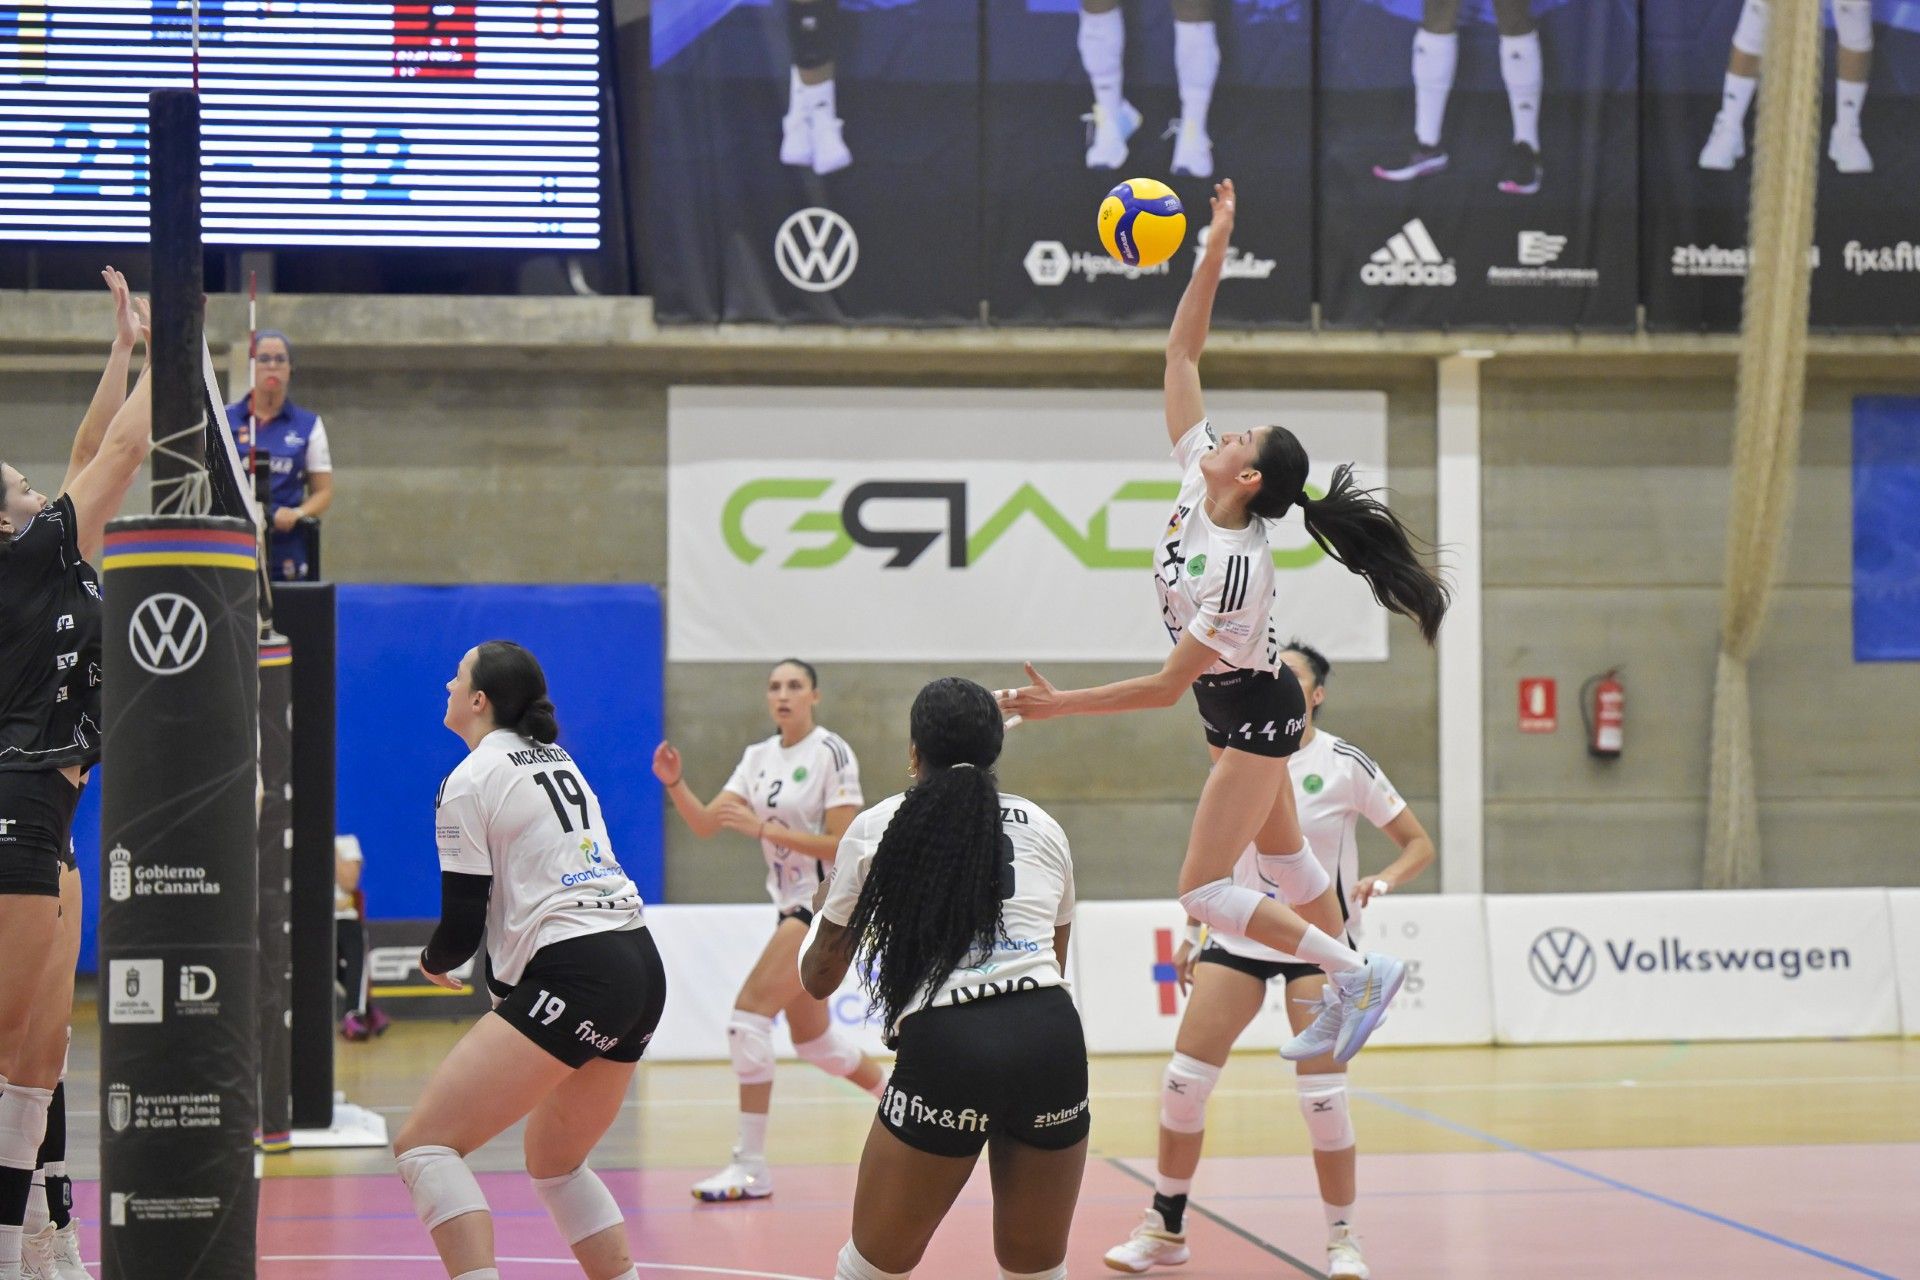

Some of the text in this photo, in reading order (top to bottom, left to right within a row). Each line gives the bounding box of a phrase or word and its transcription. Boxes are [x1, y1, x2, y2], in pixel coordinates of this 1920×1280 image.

[507, 748, 572, 767] MCKENZIE
[533, 769, 591, 833] 19
[767, 779, 783, 808] 2
[135, 864, 206, 880] Gobierno
[135, 880, 220, 895] de Canarias
[1606, 937, 1850, 979] Volkswagen
[528, 989, 566, 1026] 19
[136, 1094, 220, 1106] Ayuntamiento
[884, 1085, 989, 1132] 18 fix&fit
[180, 1105, 220, 1115] Palmas
[180, 1115, 220, 1127] Canaria
